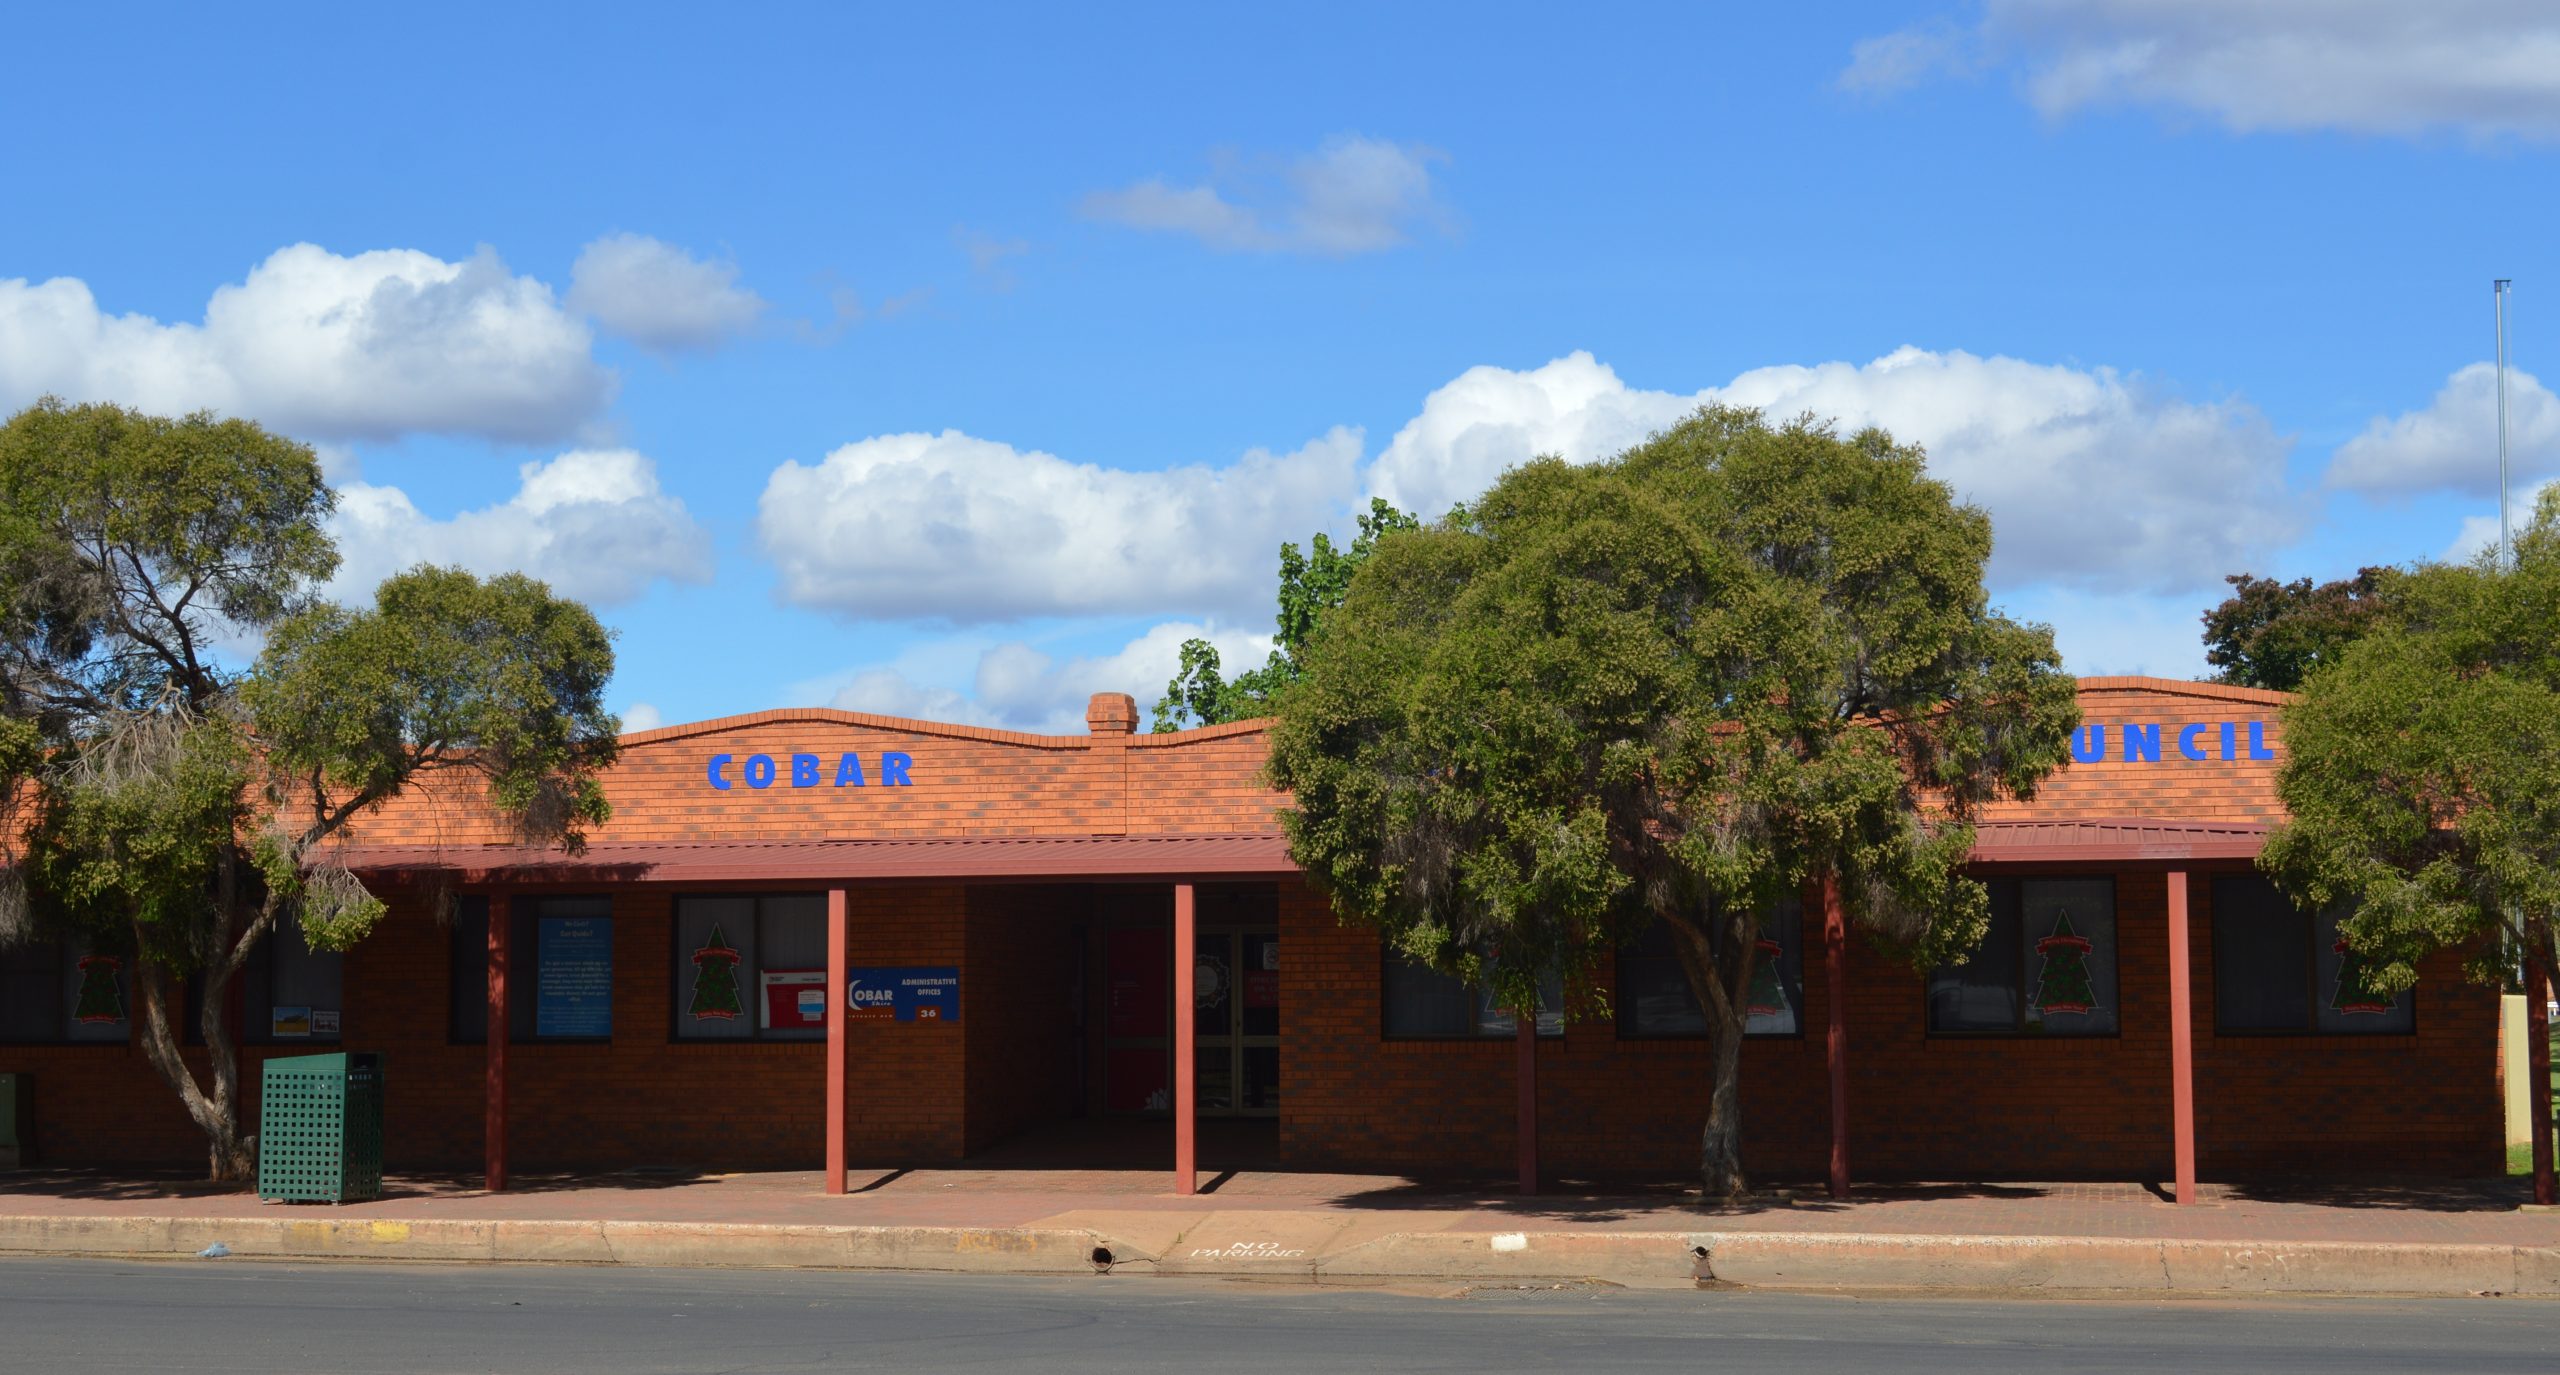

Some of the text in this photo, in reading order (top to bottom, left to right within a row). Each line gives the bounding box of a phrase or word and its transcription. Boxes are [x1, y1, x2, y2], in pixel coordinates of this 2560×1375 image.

[2071, 721, 2274, 763] UNCIL
[707, 752, 913, 790] COBAR
[901, 978, 957, 986] ADMINISTRATIVE
[917, 988, 942, 996] OFFICES
[920, 1009, 937, 1018] 36
[1231, 1242, 1280, 1250] NO
[1191, 1249, 1305, 1257] PARKING
